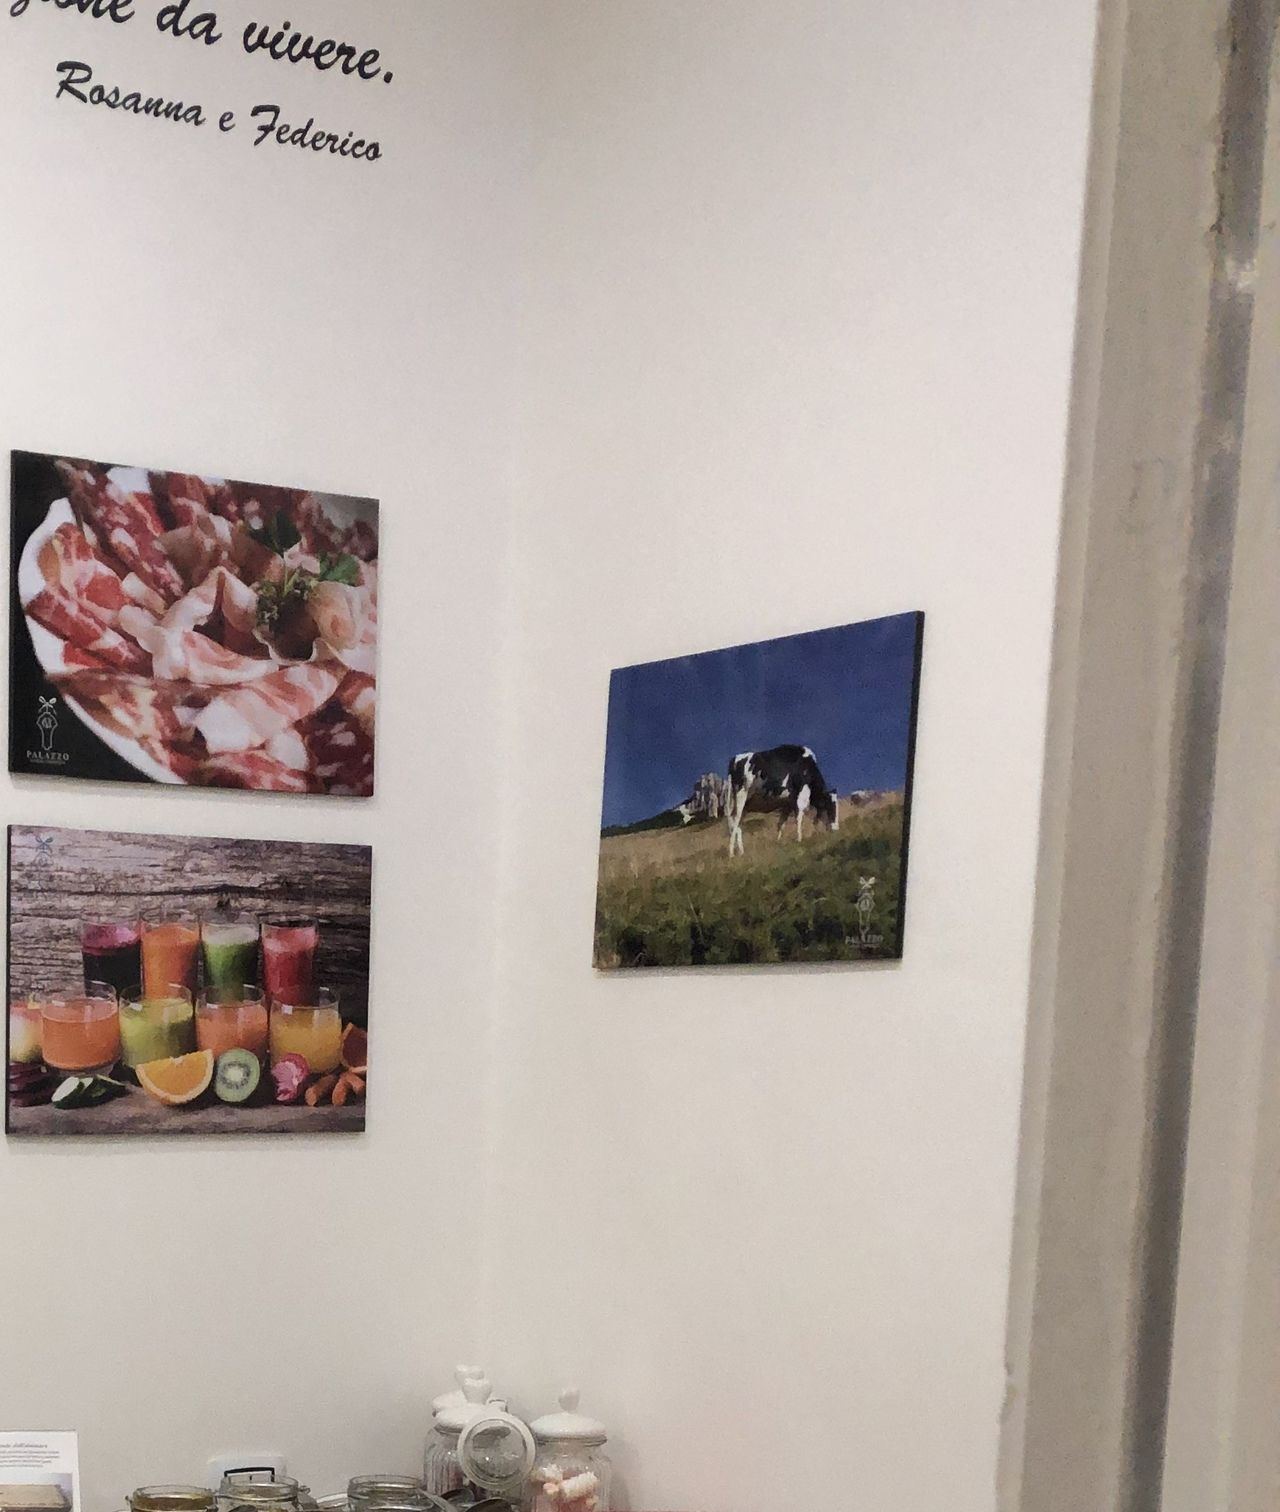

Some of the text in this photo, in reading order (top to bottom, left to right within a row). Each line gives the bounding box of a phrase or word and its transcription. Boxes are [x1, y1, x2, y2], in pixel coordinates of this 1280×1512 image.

[156, 0, 222, 45] da
[243, 21, 393, 83] vivere.
[56, 61, 382, 161] Rosanna e Federico
[26, 750, 70, 761] PALAZZO
